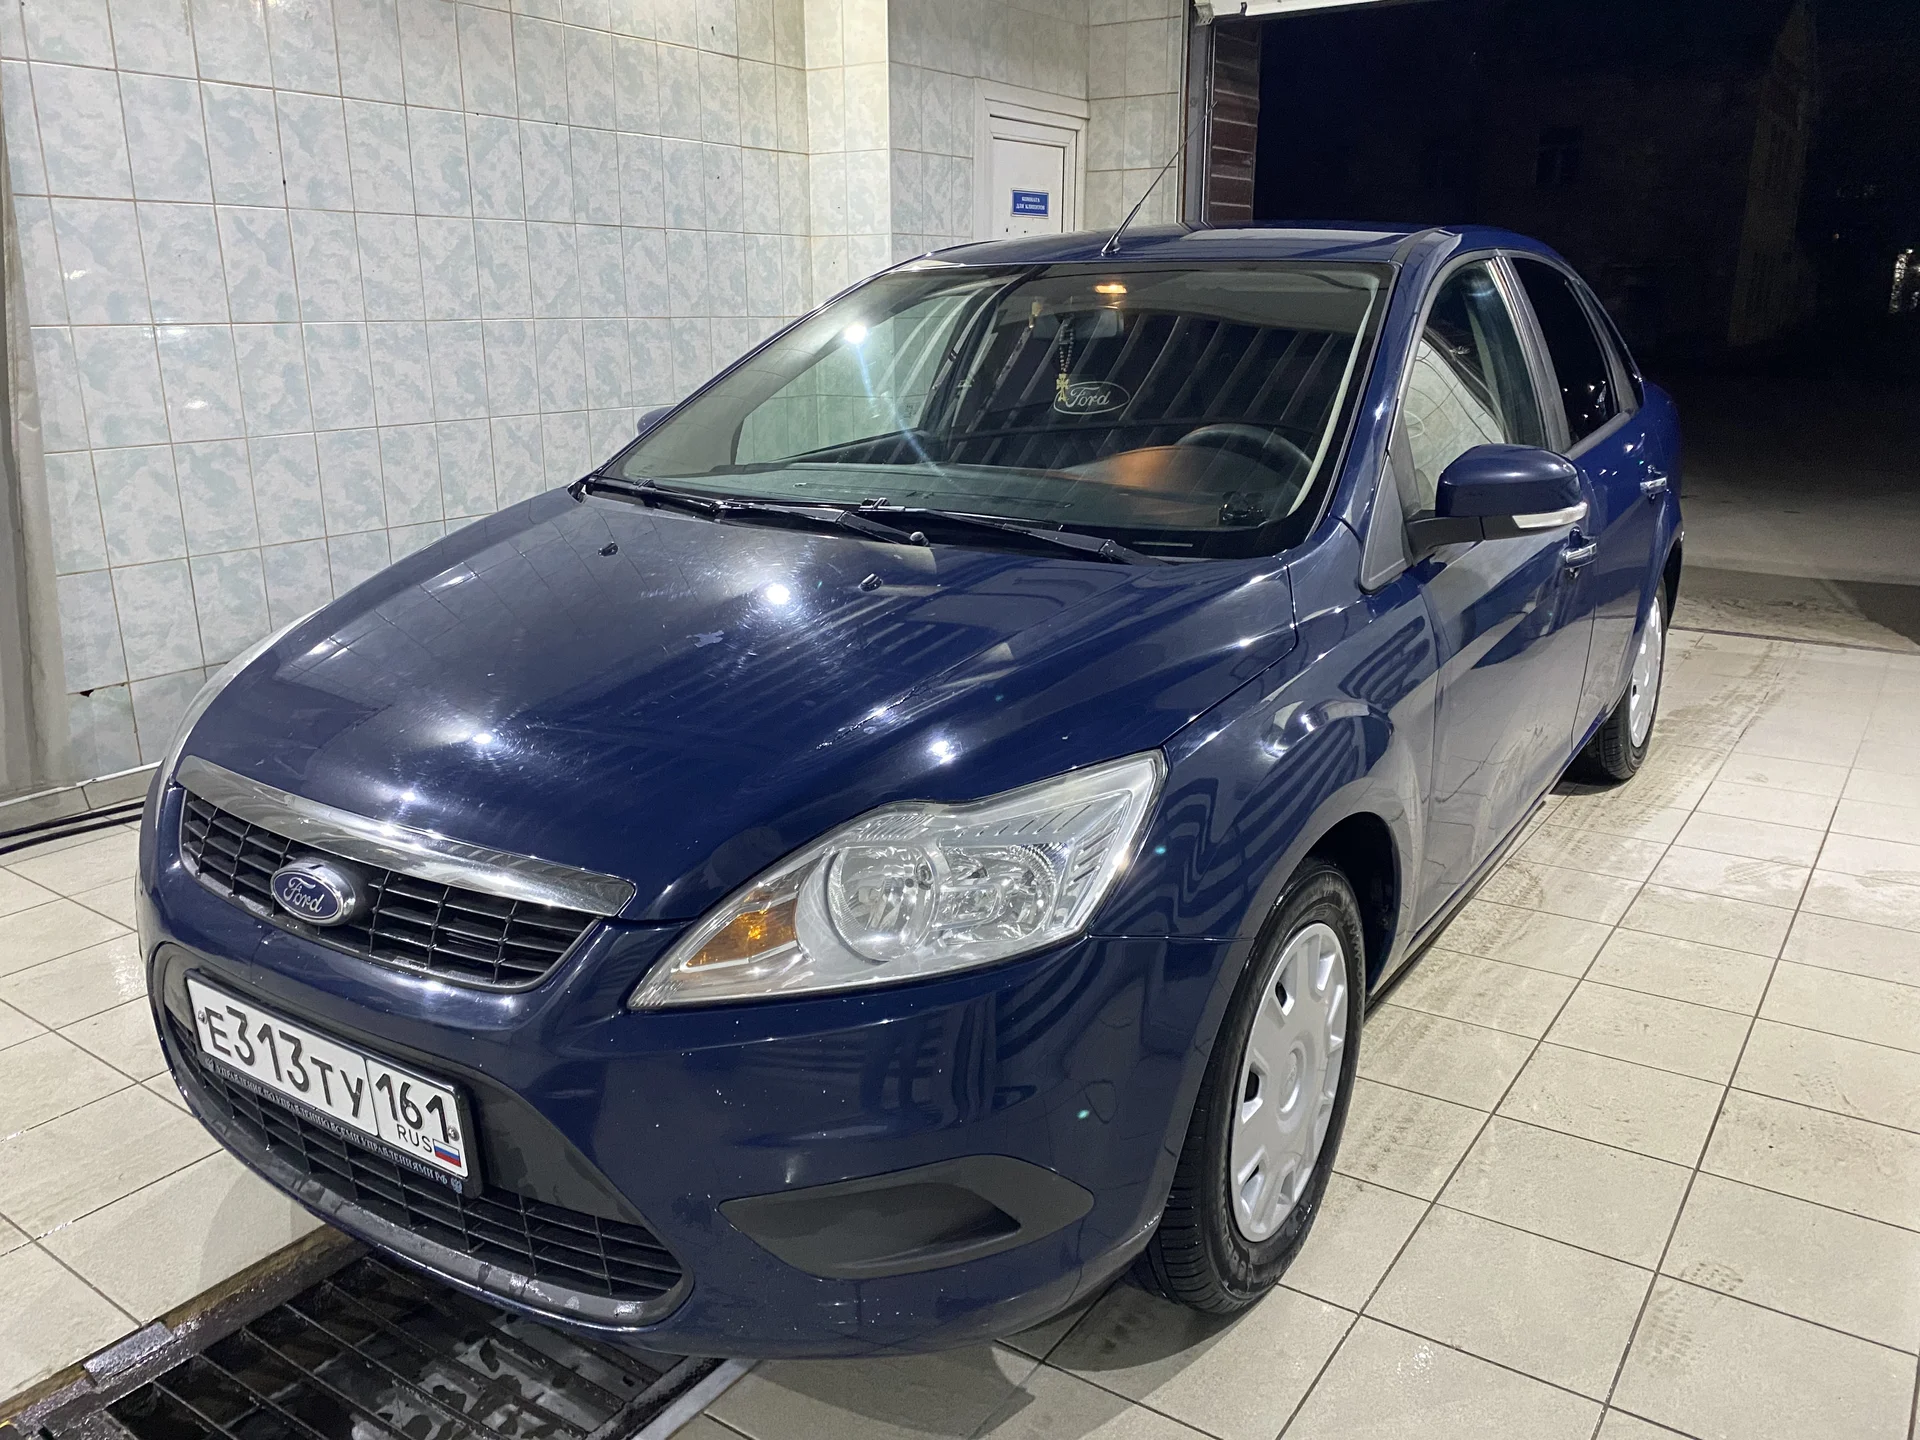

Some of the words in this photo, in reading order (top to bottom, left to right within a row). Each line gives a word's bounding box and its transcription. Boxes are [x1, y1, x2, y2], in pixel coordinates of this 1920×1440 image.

[1065, 386, 1111, 408] Ford
[283, 876, 325, 913] Ford
[397, 1123, 433, 1153] RUS
[360, 1135, 434, 1178] УПРАВЛЕНИЯМИ
[434, 1171, 448, 1185] РФ
